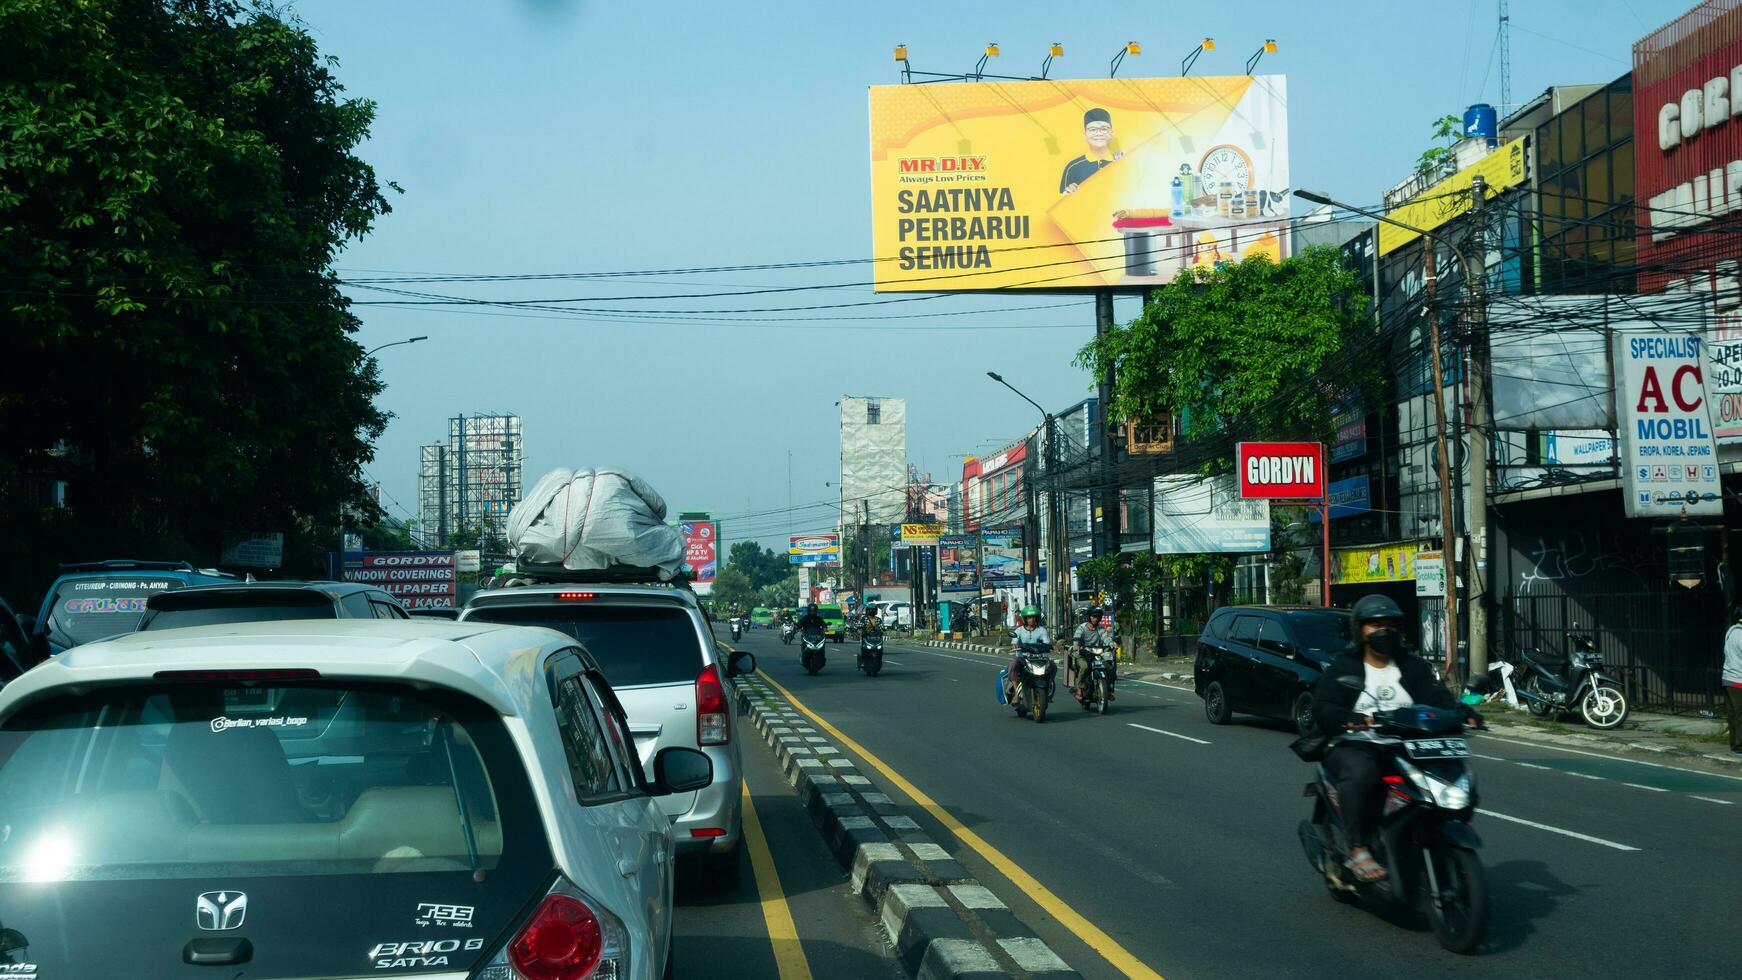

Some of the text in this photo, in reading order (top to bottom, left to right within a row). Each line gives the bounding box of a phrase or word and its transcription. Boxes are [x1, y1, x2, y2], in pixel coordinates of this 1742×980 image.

[900, 159, 936, 172] MR
[899, 174, 986, 185] Always Low Prices
[898, 187, 1015, 213] SAATNYA
[898, 215, 1030, 242] PERBARUI
[899, 244, 992, 270] SEMUA
[1631, 337, 1701, 359] SPECIALIST
[1636, 364, 1703, 413] AC
[1637, 418, 1708, 440] MOBIL
[1574, 440, 1607, 455] WALLPAPER
[1687, 445, 1710, 456] JEPANG
[1247, 455, 1315, 485] GORDYN
[373, 556, 451, 565] GORDYN
[390, 569, 452, 580] COVERINGS
[109, 582, 137, 590] CIBINONG
[375, 583, 449, 594] ALLPAPER
[415, 597, 451, 608] KACA
[368, 939, 461, 958] BRIO
[375, 956, 449, 969] SATYA
